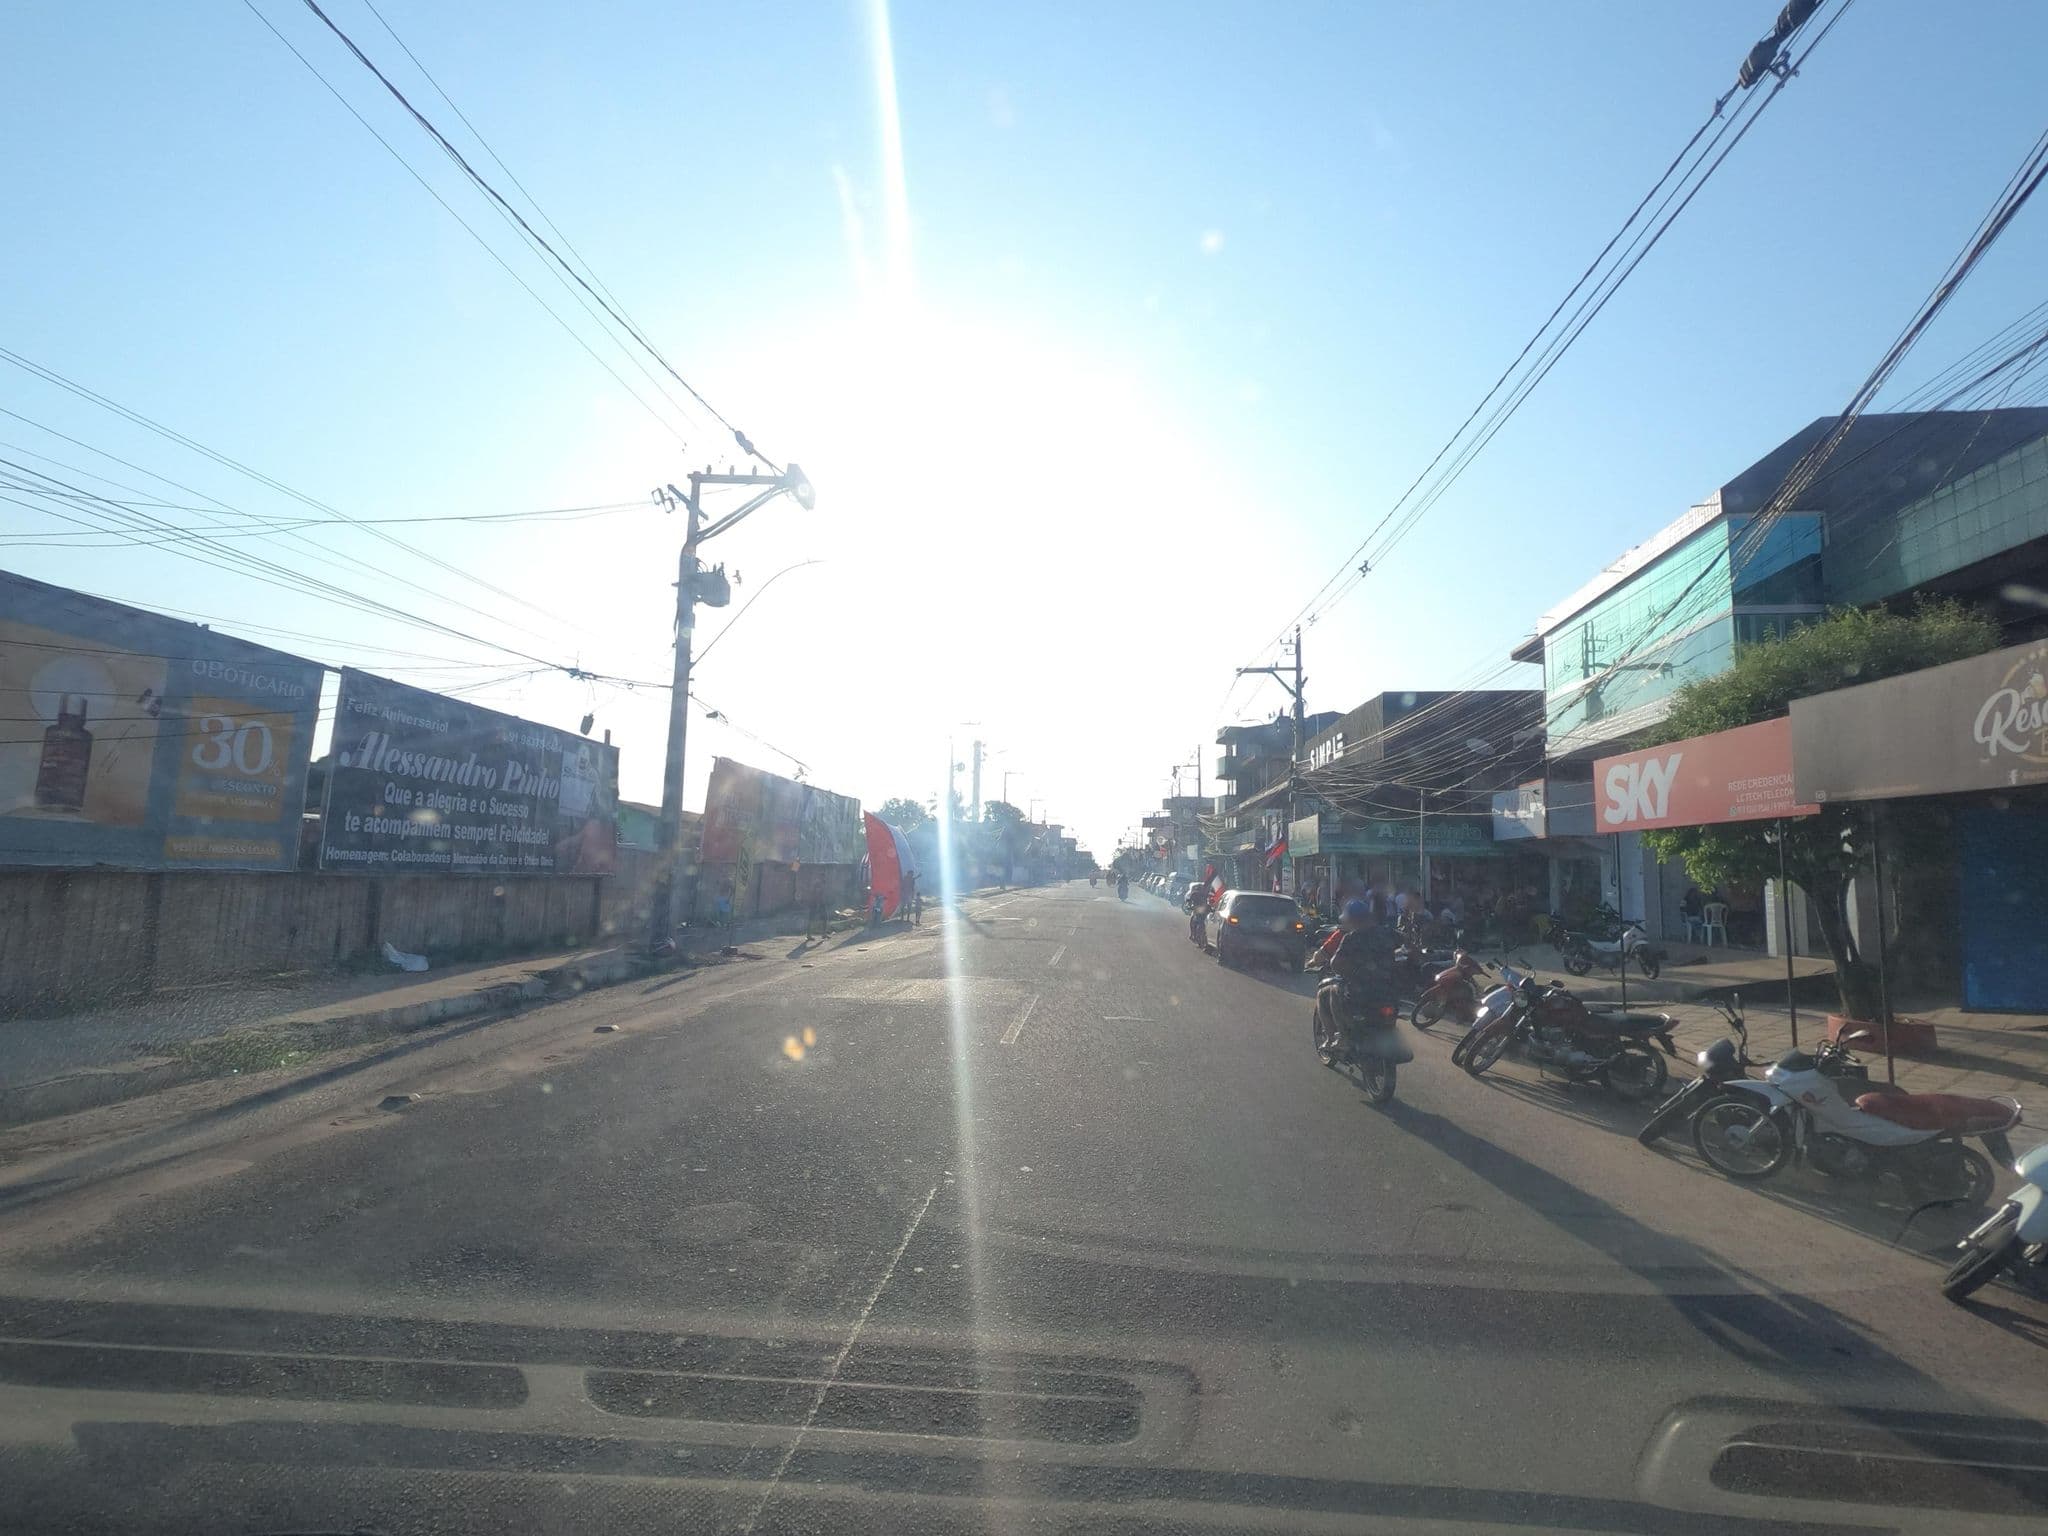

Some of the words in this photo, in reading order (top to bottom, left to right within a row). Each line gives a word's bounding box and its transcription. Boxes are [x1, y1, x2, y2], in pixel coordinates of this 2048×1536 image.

[346, 697, 378, 718] Feliz
[340, 731, 497, 790] Alessandro
[499, 759, 560, 799] Pinho
[1310, 732, 1344, 771] SIMPLE
[384, 782, 412, 805] Que
[415, 791, 424, 806] a
[427, 788, 467, 815] alegria
[469, 799, 477, 813] e
[480, 800, 487, 814] o
[489, 797, 529, 818] Sucesso
[1604, 753, 1683, 825] SKY
[345, 810, 361, 832] te
[364, 816, 451, 840] acompanhem
[454, 824, 497, 846] sempre!
[500, 825, 550, 845] Felicidade!
[391, 849, 451, 864] Colaboradores
[489, 853, 497, 865] da
